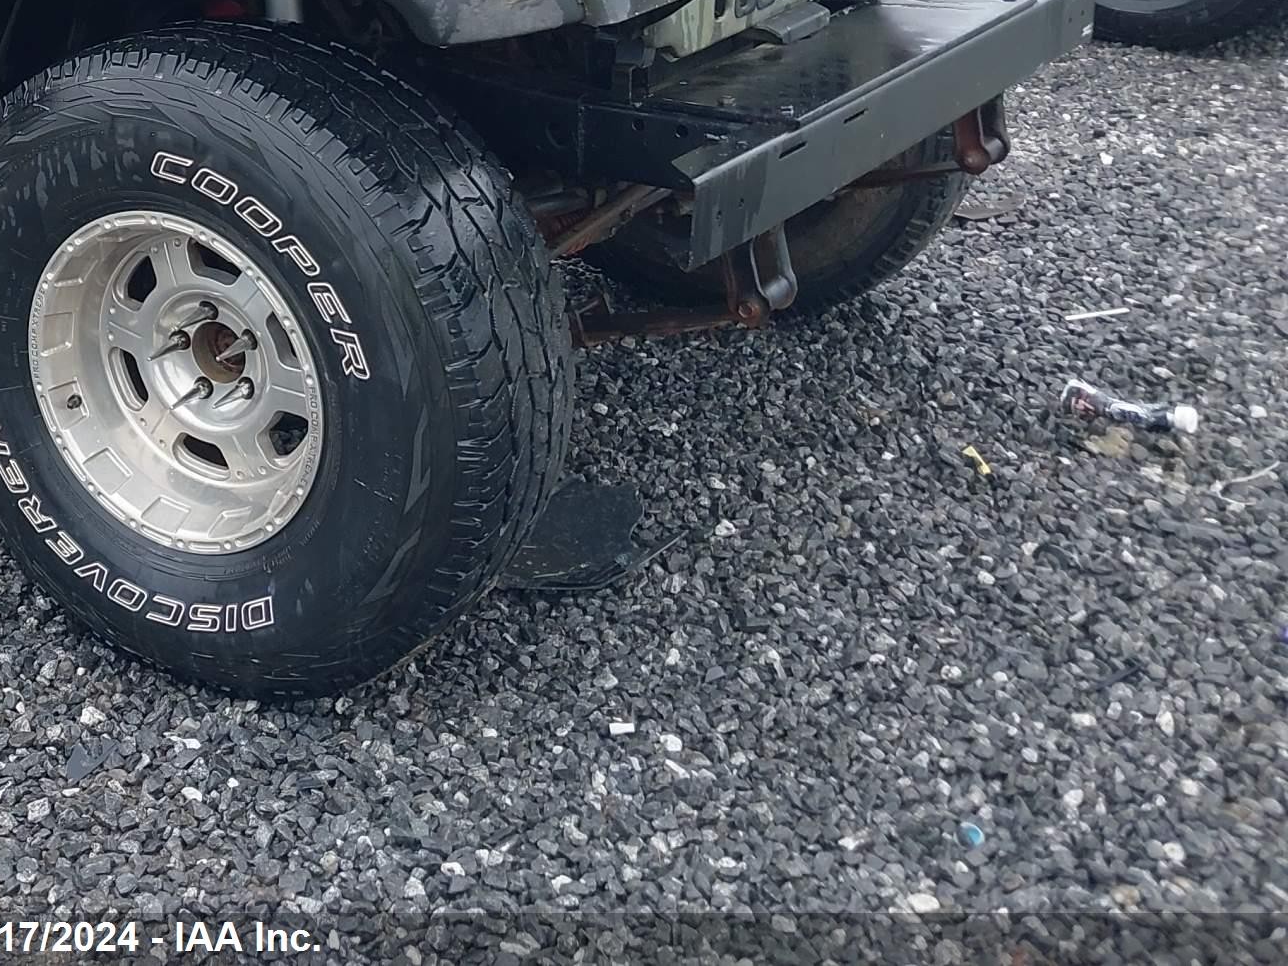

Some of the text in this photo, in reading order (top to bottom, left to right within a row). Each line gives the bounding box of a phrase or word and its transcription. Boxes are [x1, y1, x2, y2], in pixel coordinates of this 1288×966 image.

[151, 150, 371, 381] COOPER
[31, 328, 39, 357] COMP
[309, 386, 318, 409] PRO
